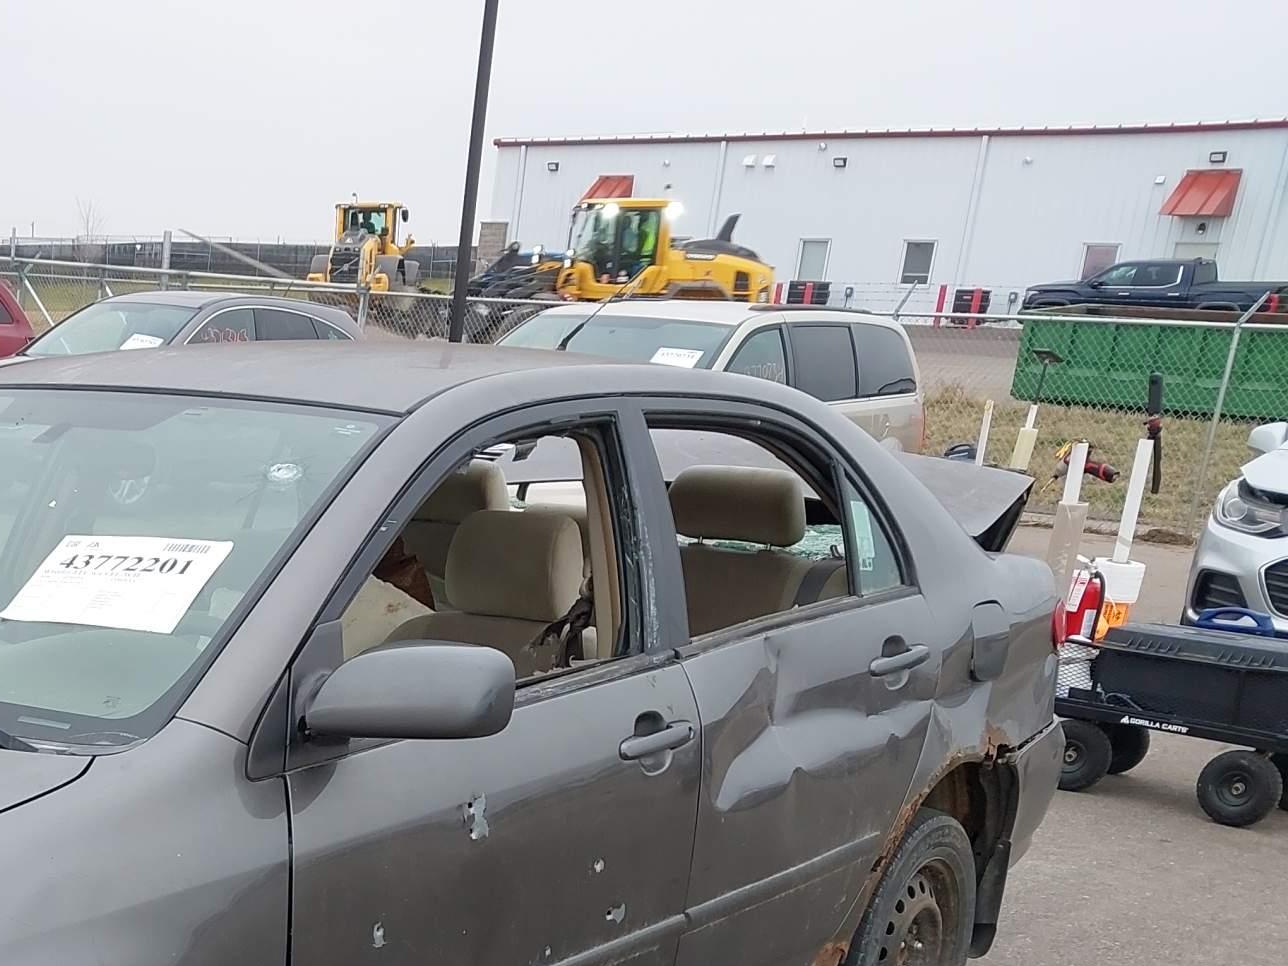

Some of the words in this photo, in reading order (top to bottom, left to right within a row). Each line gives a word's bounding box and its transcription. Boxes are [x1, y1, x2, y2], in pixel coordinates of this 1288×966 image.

[59, 554, 194, 575] 43772201
[1130, 717, 1160, 729] GORILLA
[1161, 723, 1188, 733] CARTS
